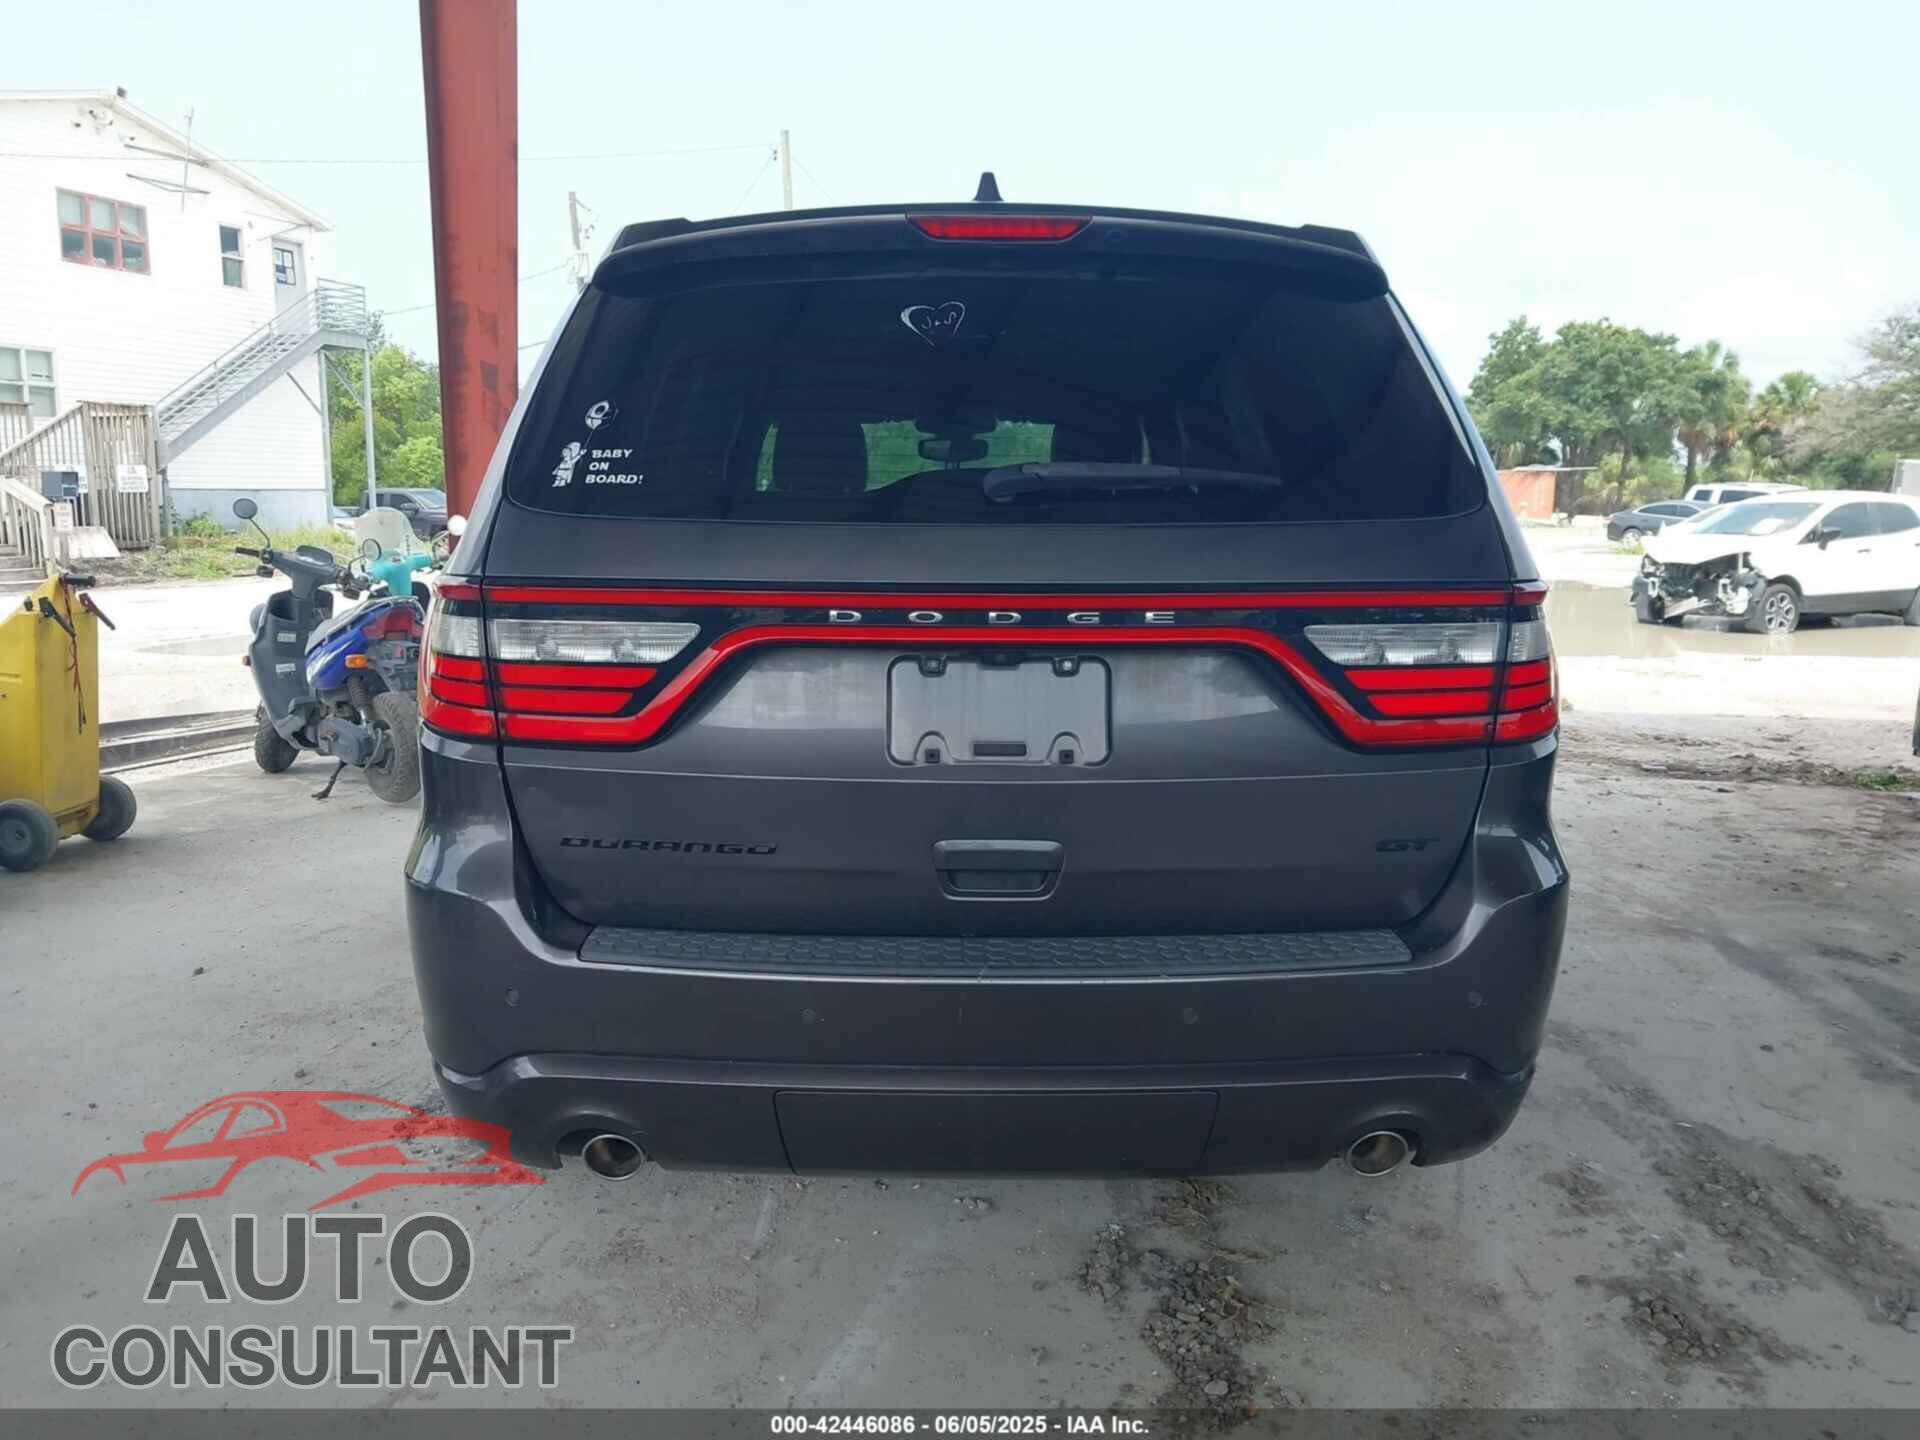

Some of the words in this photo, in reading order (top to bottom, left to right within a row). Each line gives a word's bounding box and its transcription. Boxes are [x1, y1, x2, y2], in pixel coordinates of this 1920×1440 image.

[591, 448, 633, 459] BABY
[588, 461, 610, 471] ON
[585, 474, 644, 485] BOARD!
[829, 609, 1175, 625] DODGE
[559, 836, 778, 855] DURANGO
